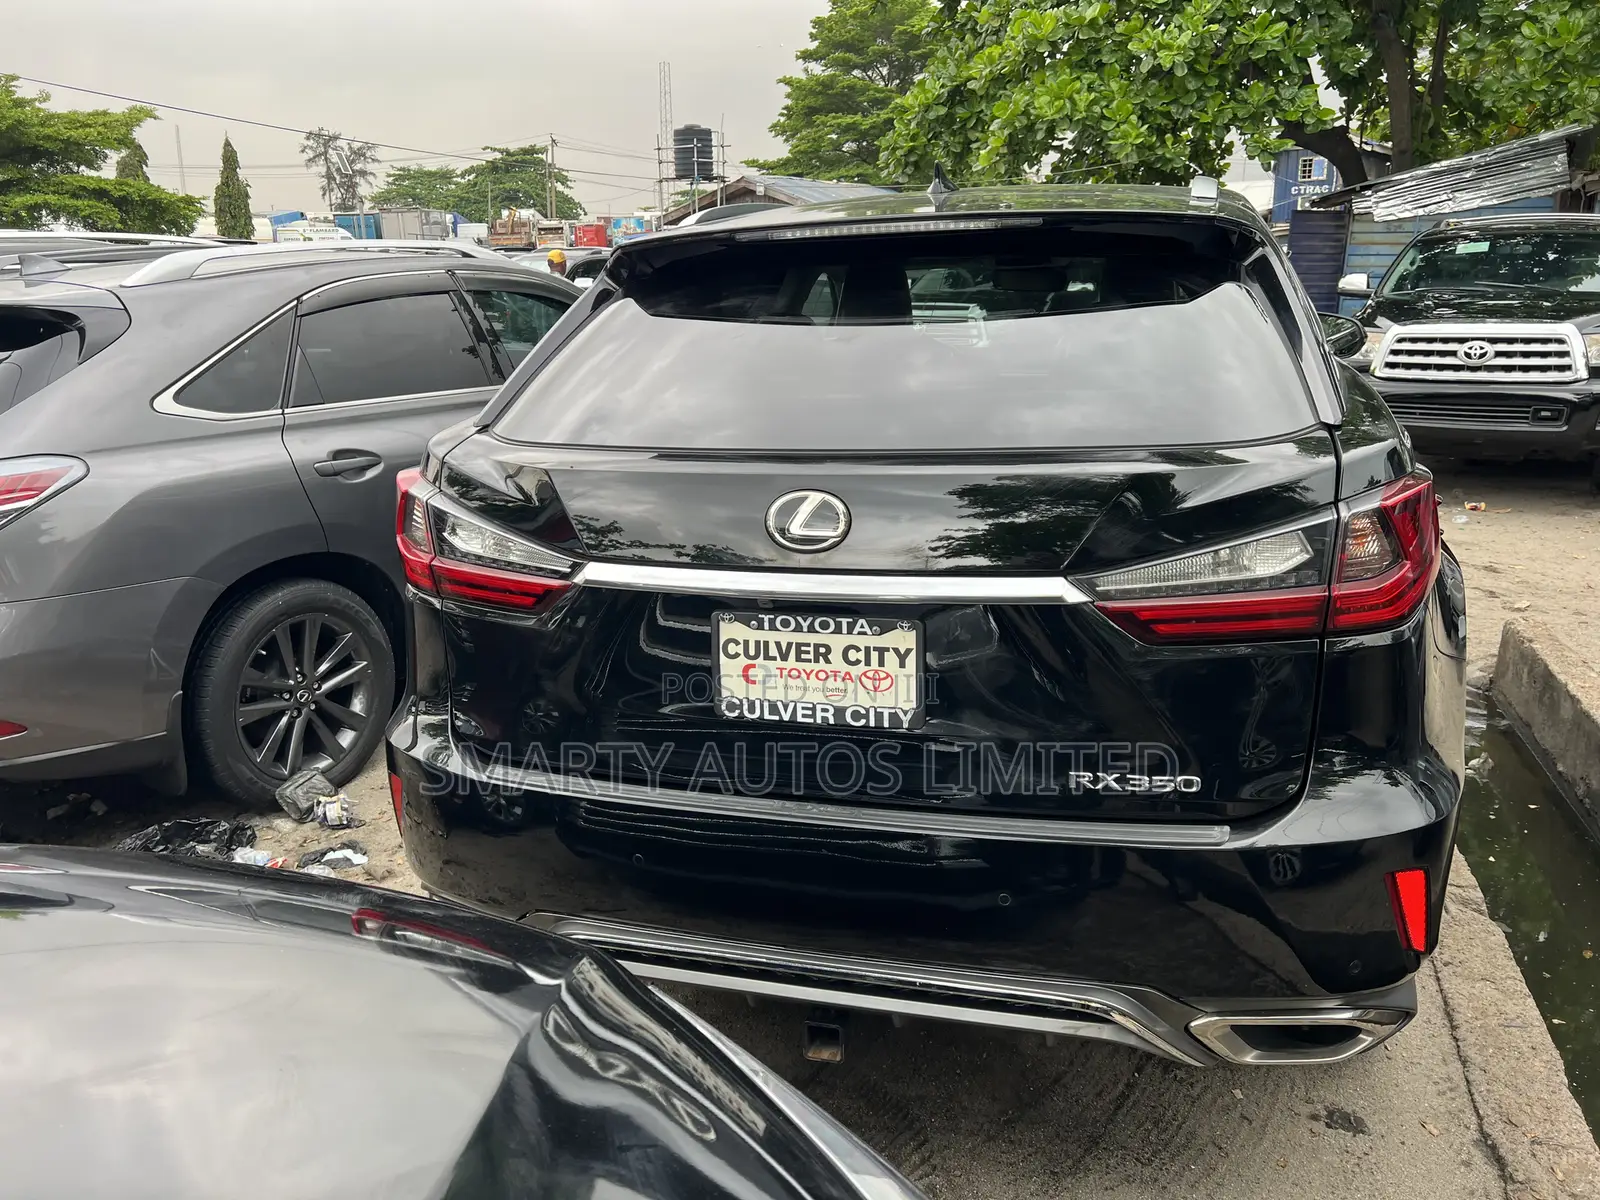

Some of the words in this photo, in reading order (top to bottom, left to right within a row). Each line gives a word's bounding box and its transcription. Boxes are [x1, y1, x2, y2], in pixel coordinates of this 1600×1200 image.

[758, 614, 873, 635] TOYOTA
[721, 638, 832, 665] CULVER
[841, 645, 915, 669] CITY
[776, 667, 854, 684] TOYOTA
[782, 683, 794, 691] We
[811, 686, 824, 694] you
[721, 696, 835, 725] CULVER
[844, 705, 916, 729] CITY
